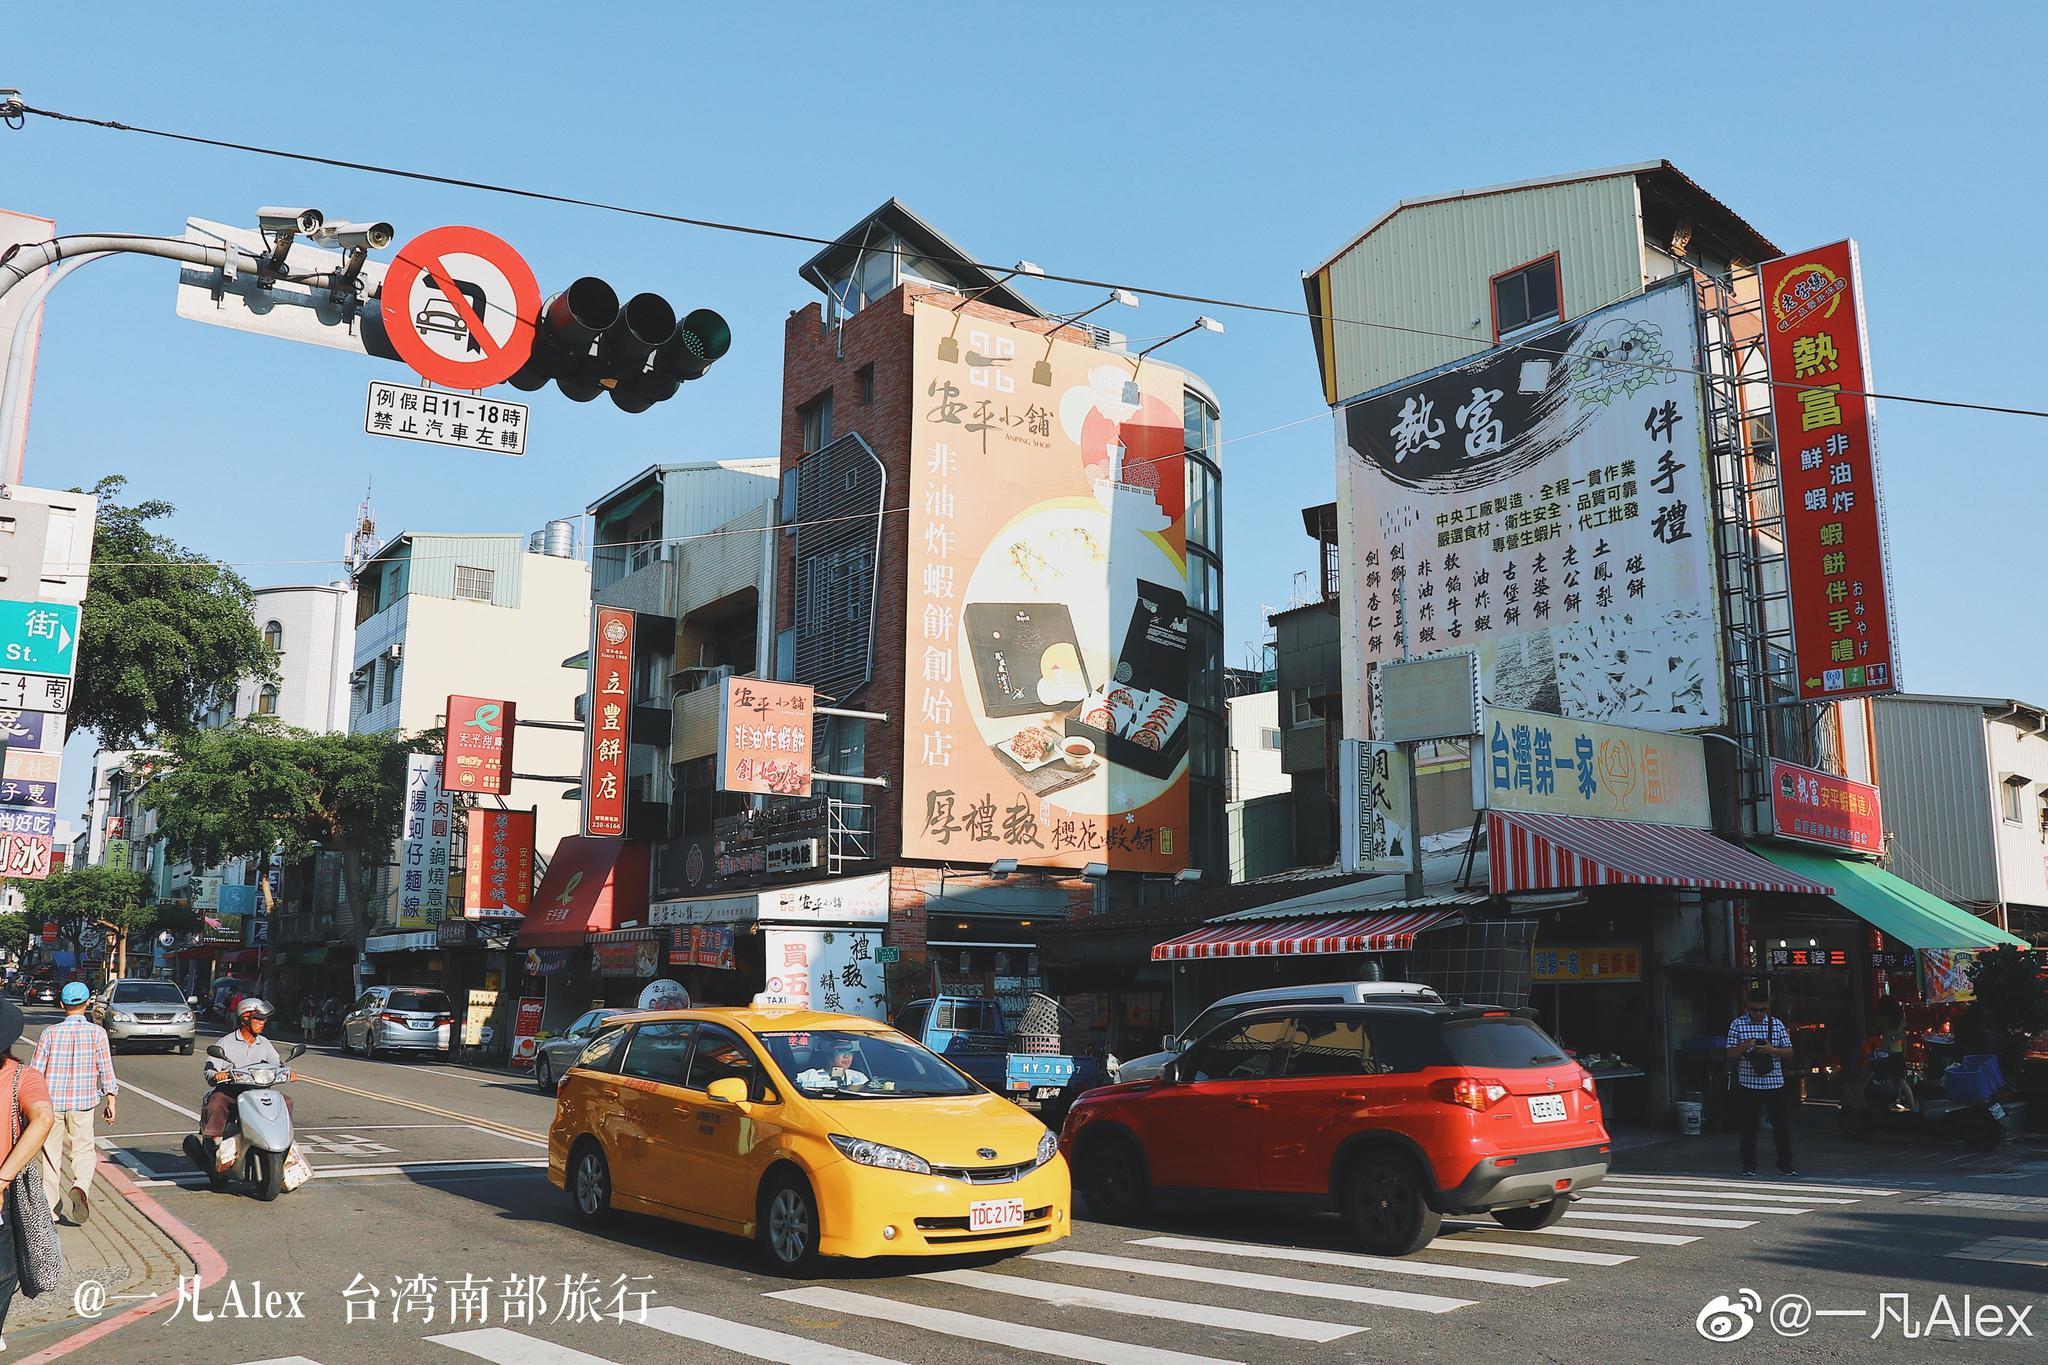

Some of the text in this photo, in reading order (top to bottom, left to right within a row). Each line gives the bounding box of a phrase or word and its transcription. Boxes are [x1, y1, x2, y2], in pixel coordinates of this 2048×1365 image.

[376, 387, 521, 428] 例假日11-18時
[1793, 330, 1843, 434] 熱富
[373, 410, 519, 450] 禁止汽車左轉
[1005, 433, 1031, 447] ANPING
[1390, 386, 1504, 464] 熱富
[1644, 399, 1692, 546] 伴手禮
[1800, 448, 1828, 512] 鮮蝦
[1826, 433, 1855, 514] 非油炸
[920, 441, 959, 768] 非油炸蝦餅創始店
[1473, 568, 1493, 633] 油炸蝦
[1532, 552, 1551, 620] 老婆餅
[1561, 544, 1581, 612] 老公餅
[1592, 538, 1614, 609] 土鳳梨
[1820, 521, 1855, 662] 蝦餅伴手禮
[6, 643, 37, 663] St.
[24, 608, 59, 640] 街
[1852, 580, 1869, 658] おみやげ
[45, 679, 68, 699] 南
[594, 669, 626, 801] 立豐餅店
[734, 723, 806, 753] 非油炸蝦餅
[1491, 720, 1597, 800] 台灣第一家
[735, 757, 801, 786] 創始店
[403, 764, 429, 919] 大腸蚵仔麵線
[766, 996, 788, 1004] TAXI
